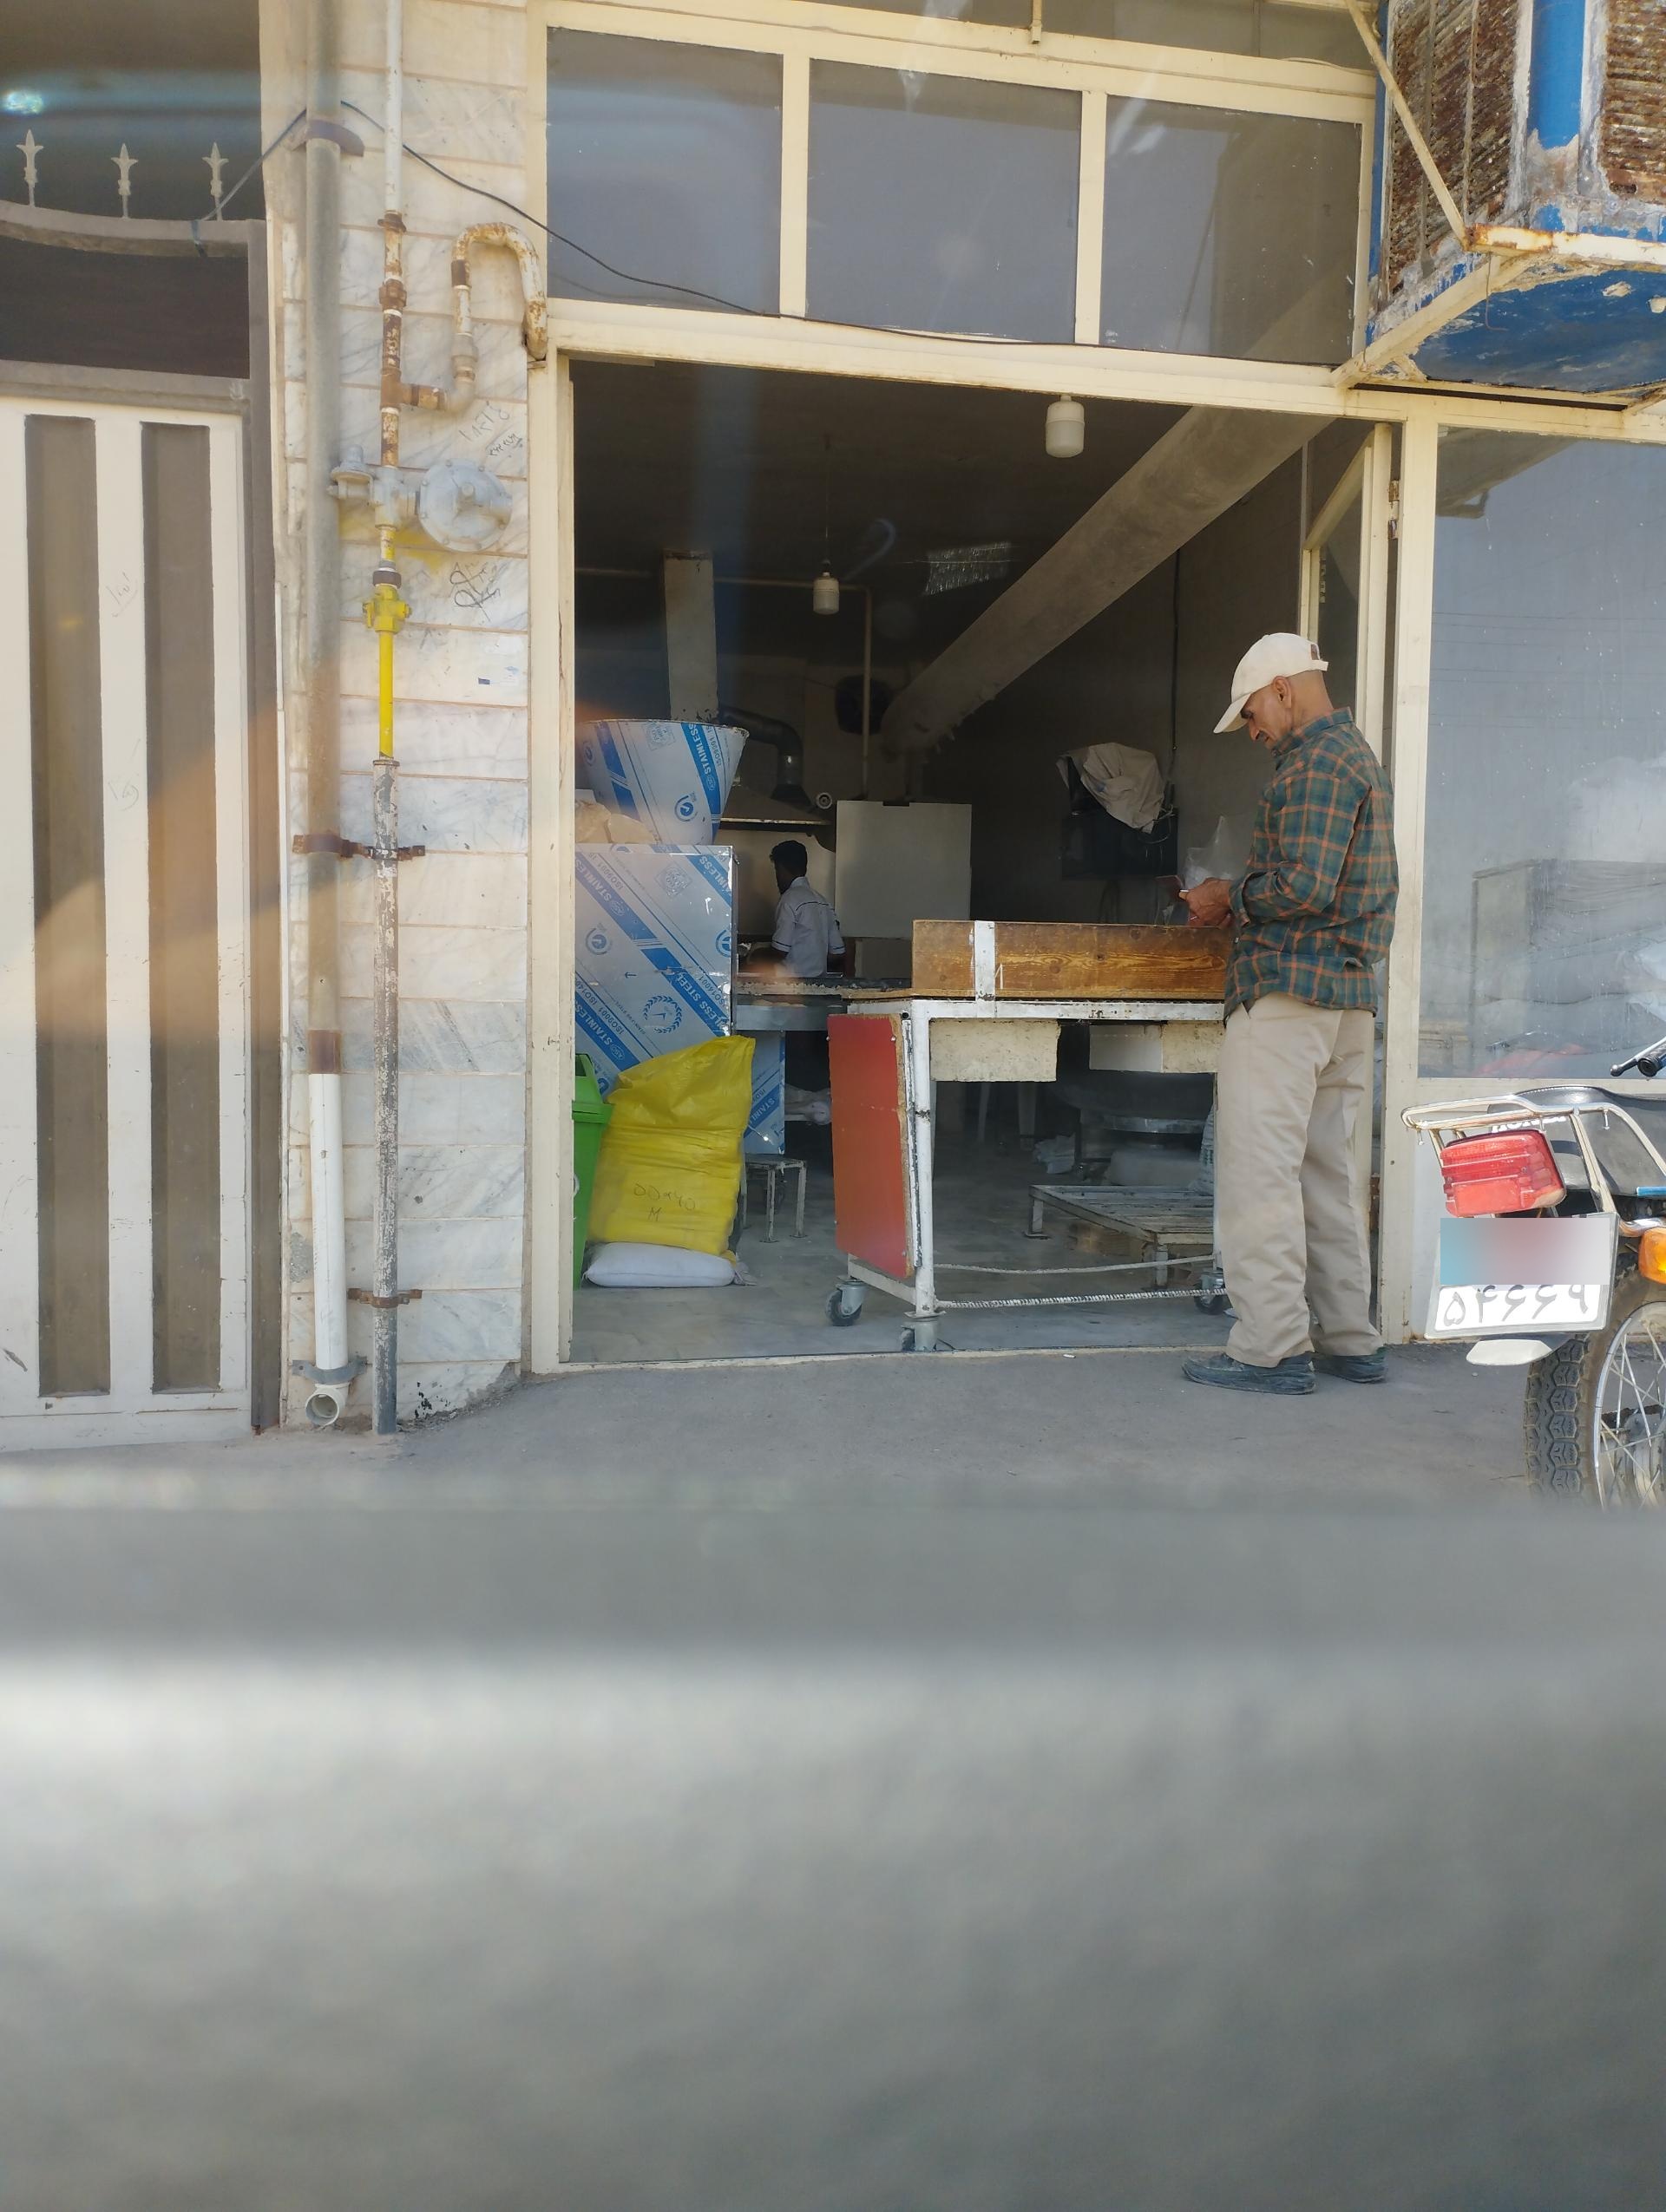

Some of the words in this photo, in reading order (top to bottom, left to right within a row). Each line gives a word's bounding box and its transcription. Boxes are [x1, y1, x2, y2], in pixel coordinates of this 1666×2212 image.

[688, 723, 711, 775] STAINLESS
[575, 859, 613, 901] STAINLES
[699, 855, 731, 895] AINLESS
[575, 1000, 613, 1045] STAINLES
[599, 1007, 624, 1035] ISO9001
